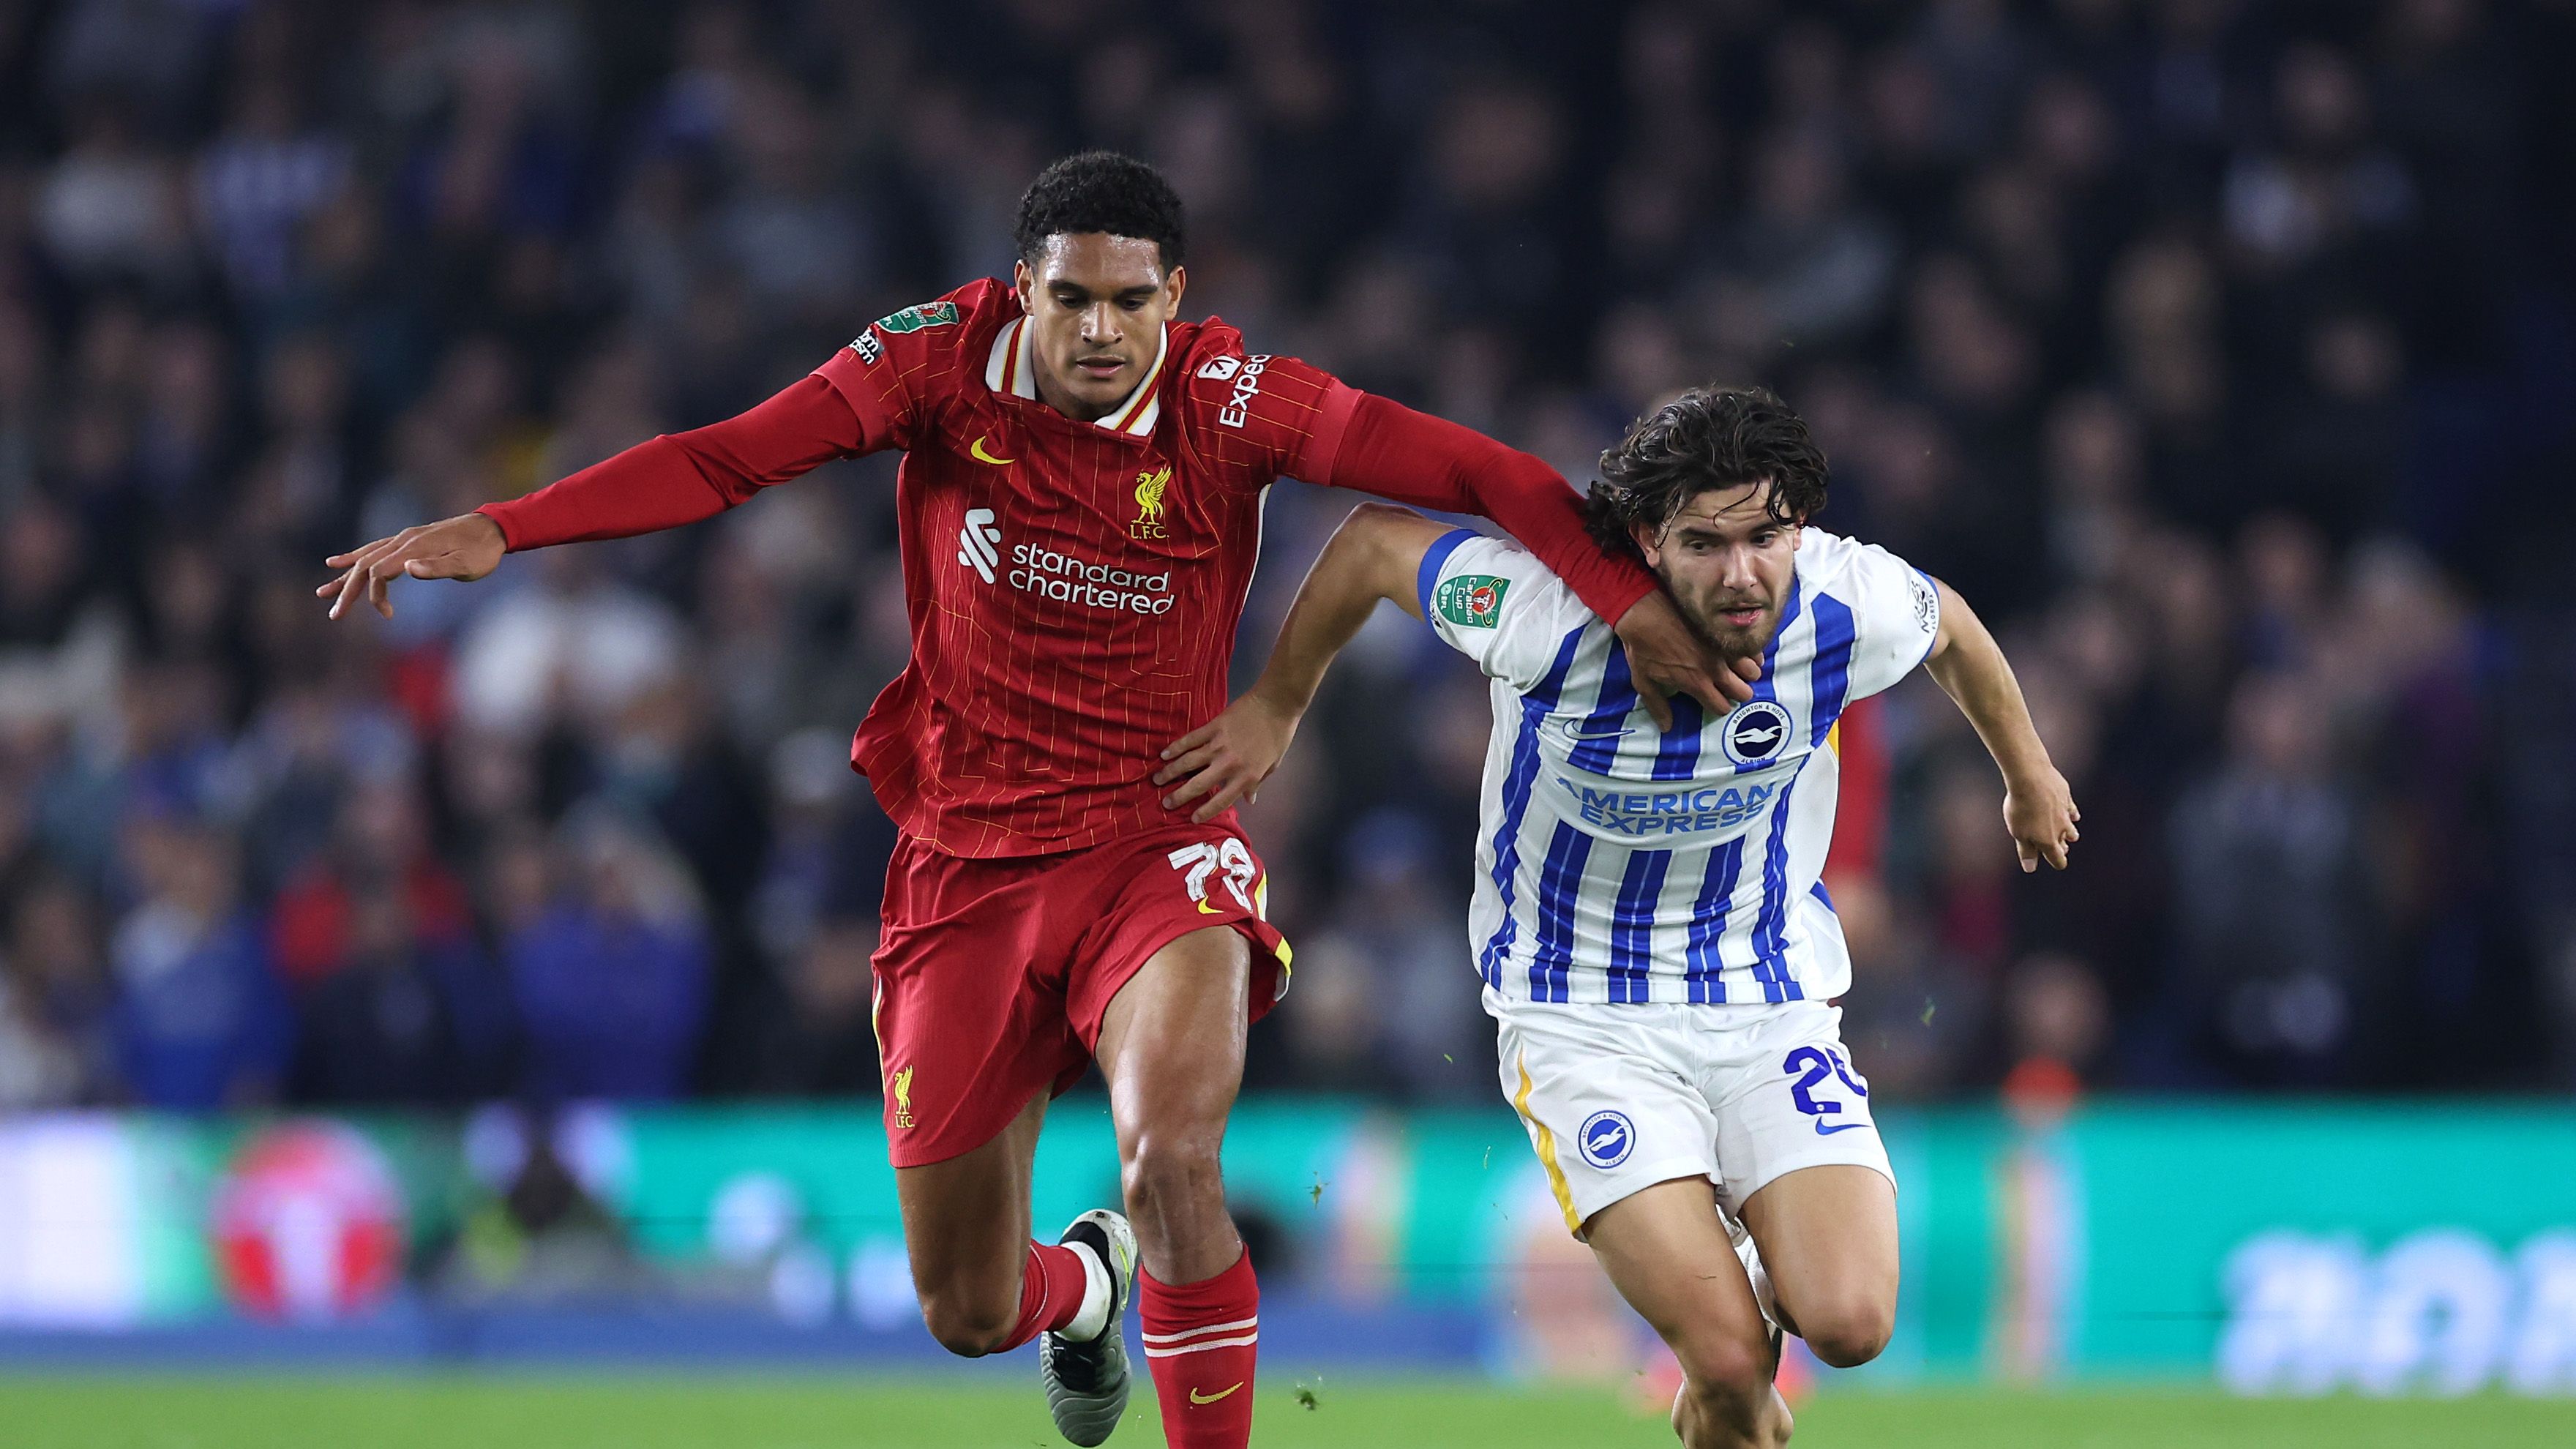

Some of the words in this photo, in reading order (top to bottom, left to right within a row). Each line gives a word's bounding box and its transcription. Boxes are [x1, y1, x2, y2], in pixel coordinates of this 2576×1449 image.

[1011, 542, 1169, 593] standard
[1008, 568, 1175, 615] chartered
[1456, 588, 1466, 609] Cup
[1466, 577, 1477, 623] Carabao
